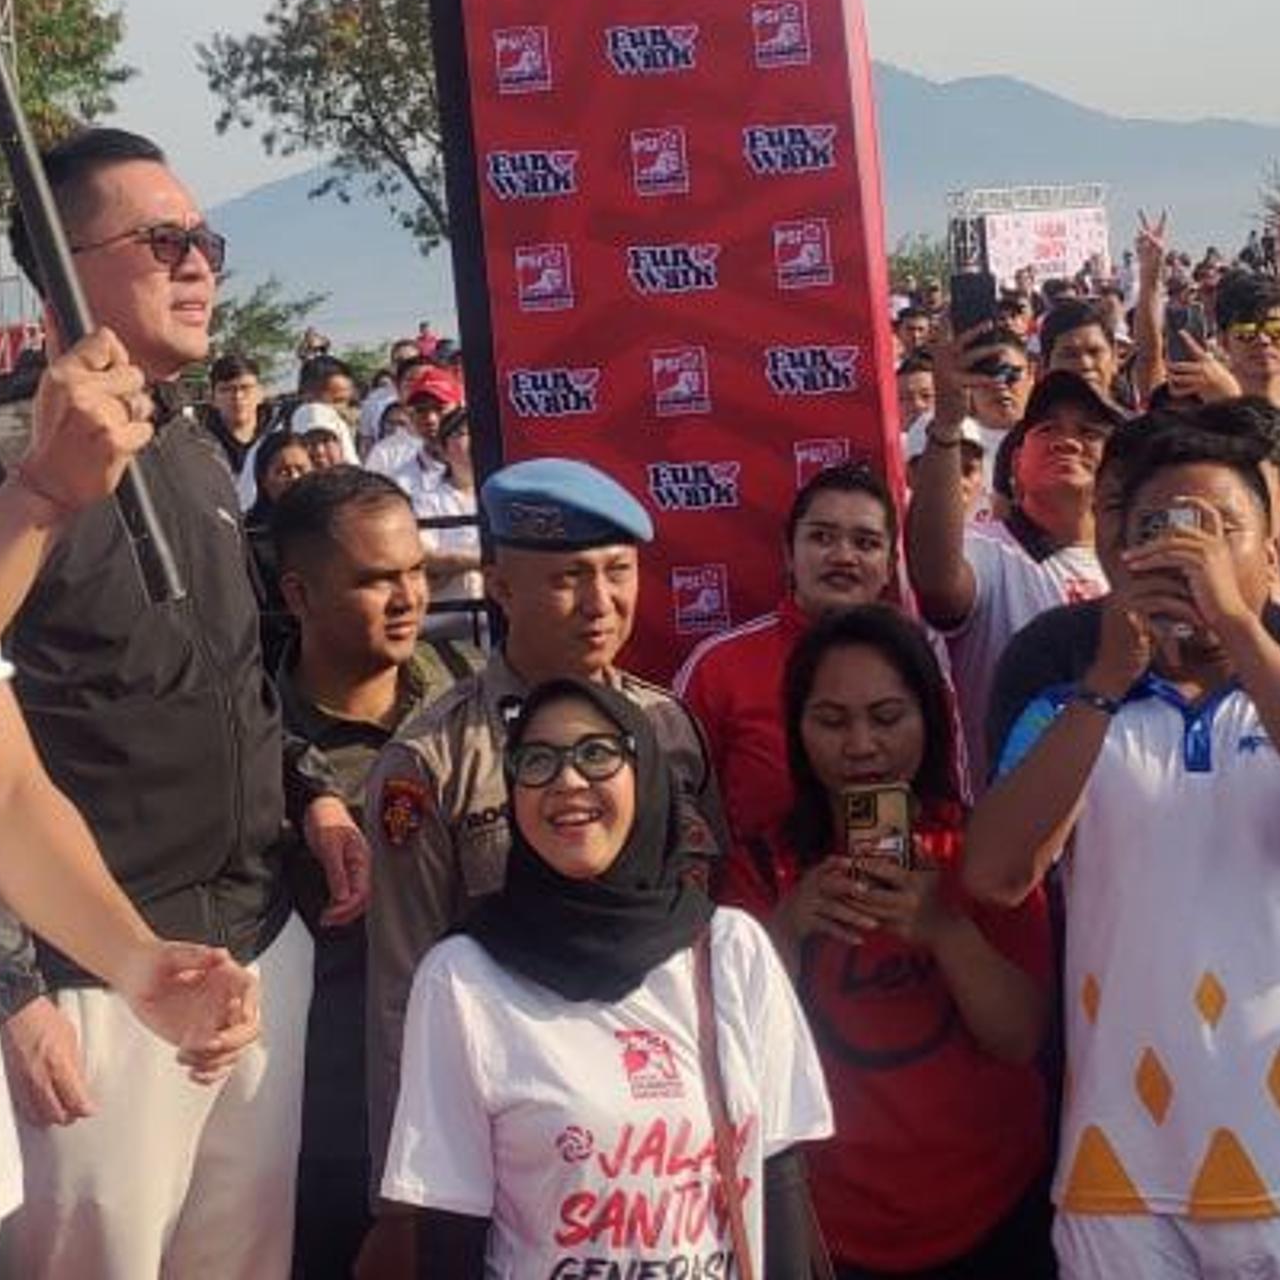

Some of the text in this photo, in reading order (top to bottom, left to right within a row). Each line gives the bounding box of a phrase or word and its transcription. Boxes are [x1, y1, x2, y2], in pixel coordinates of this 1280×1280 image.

[611, 28, 669, 50] Fun
[746, 127, 807, 149] Fun
[490, 154, 551, 175] Fun
[631, 248, 690, 269] Fun
[769, 349, 829, 370] Fun
[511, 371, 571, 392] Fun
[652, 466, 714, 489] Fun
